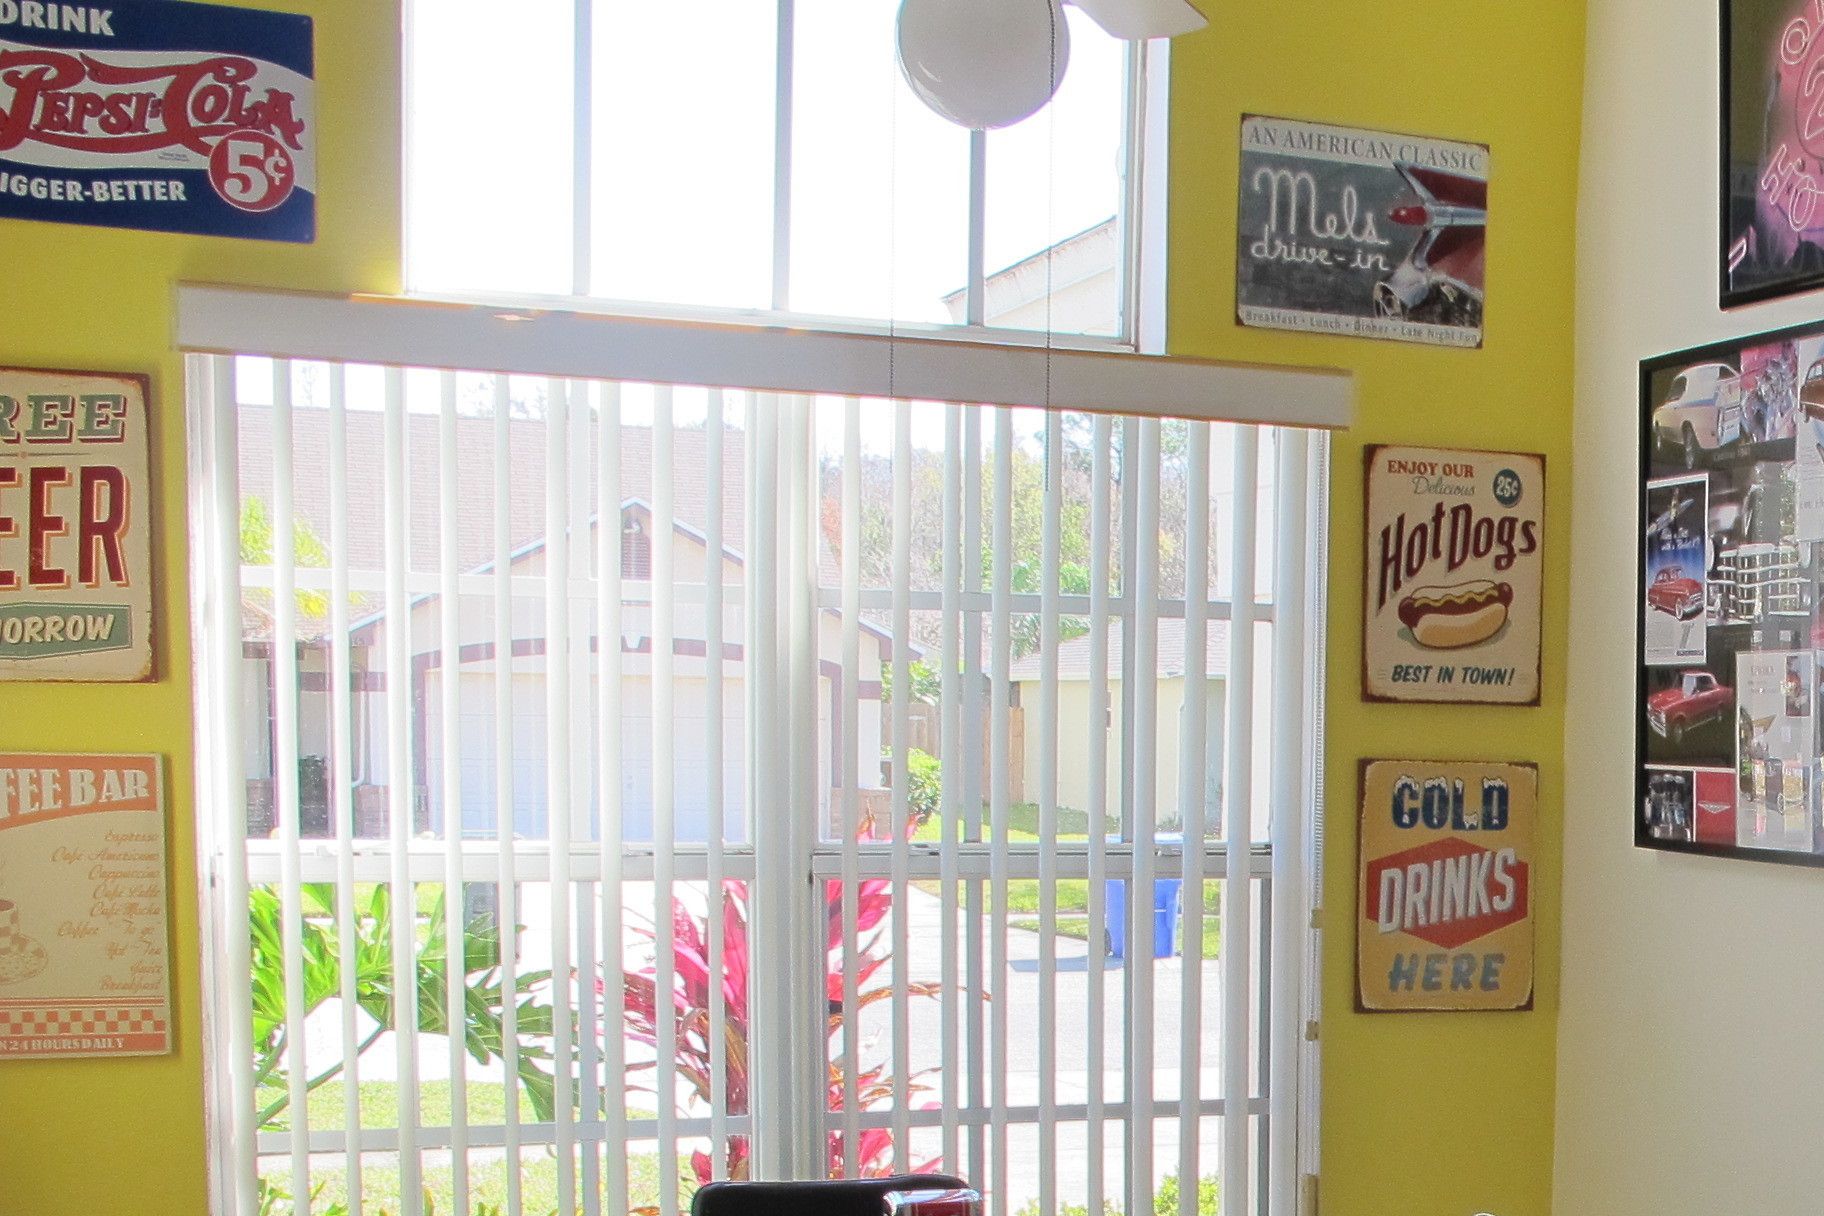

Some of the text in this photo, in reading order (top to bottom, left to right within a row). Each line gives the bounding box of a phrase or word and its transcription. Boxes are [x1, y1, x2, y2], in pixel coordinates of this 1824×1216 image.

[0, 0, 115, 36] DRINK
[1250, 126, 1482, 171] AN AMERICAN CLASSIC
[1254, 167, 1390, 245] Mels
[1250, 223, 1390, 271] drive-in
[1245, 310, 1299, 326] Breakfast
[1309, 318, 1341, 330] Lunch
[1388, 459, 1475, 478] ENJOY OUR
[1412, 475, 1476, 496] Delicious
[1448, 502, 1537, 572] Dogs
[0, 614, 115, 644] ORROW
[1391, 664, 1516, 687] BEST IN TOWN!
[69, 769, 150, 806] BAR
[1391, 775, 1510, 830] COLD
[1379, 848, 1517, 935] DRINKS
[1388, 953, 1506, 992] HERE
